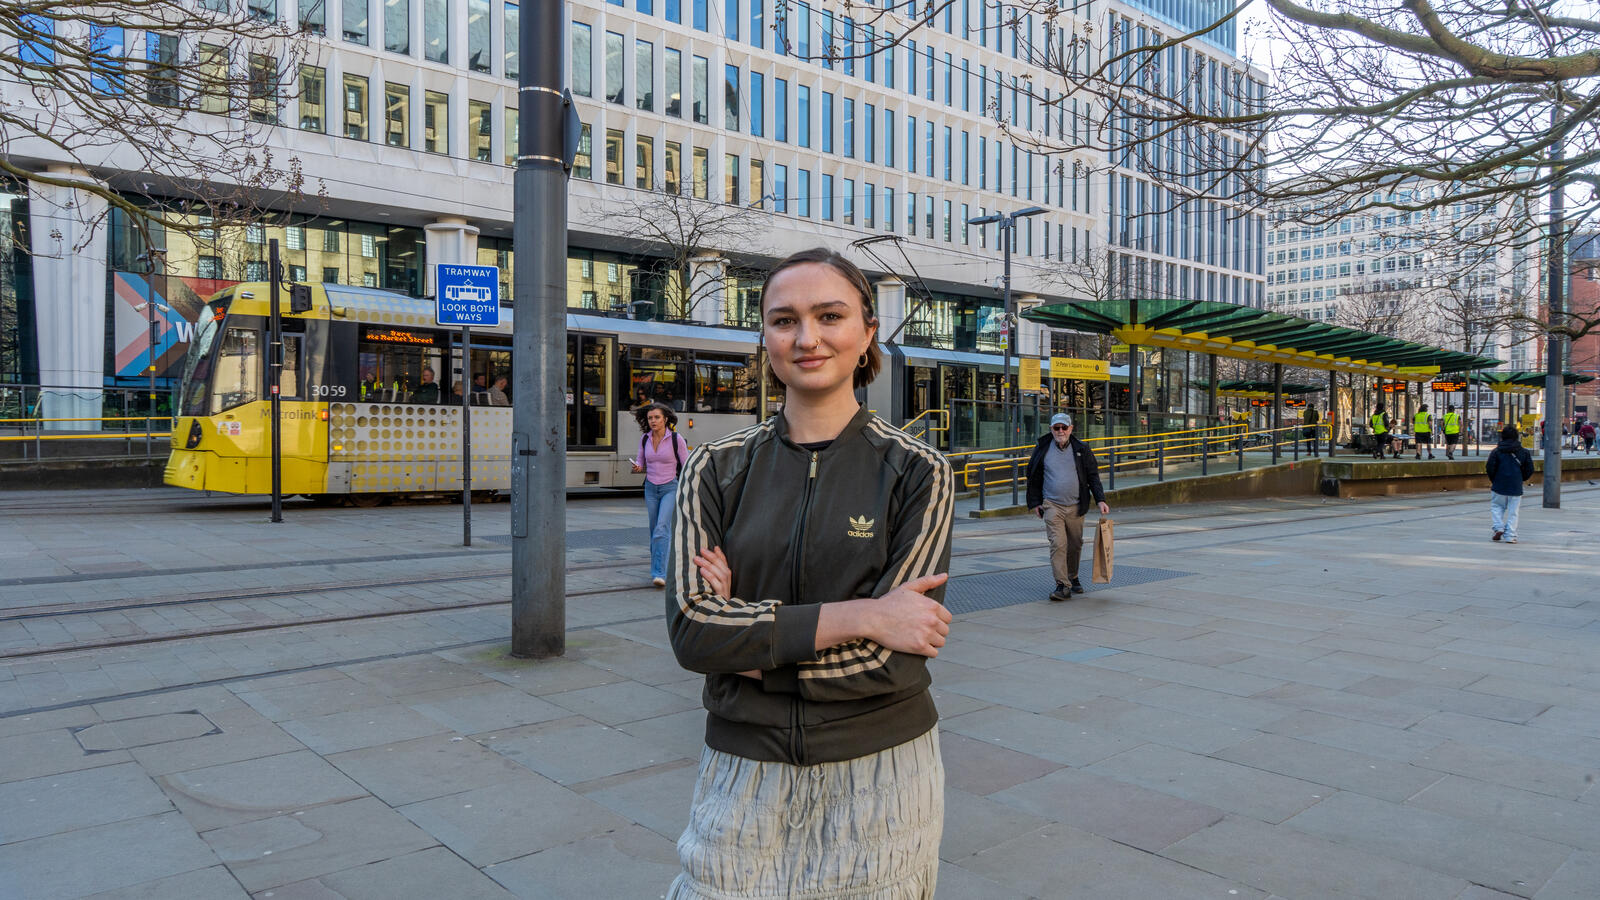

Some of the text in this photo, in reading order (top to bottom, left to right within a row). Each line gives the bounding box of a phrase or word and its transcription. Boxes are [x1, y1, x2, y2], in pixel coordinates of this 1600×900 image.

[445, 268, 491, 277] TRAMWAY
[442, 304, 495, 313] LOOK BOTH
[456, 313, 482, 321] WAYS
[312, 385, 346, 397] 3059
[260, 406, 318, 419] Mtrolink
[847, 530, 874, 538] adidas
